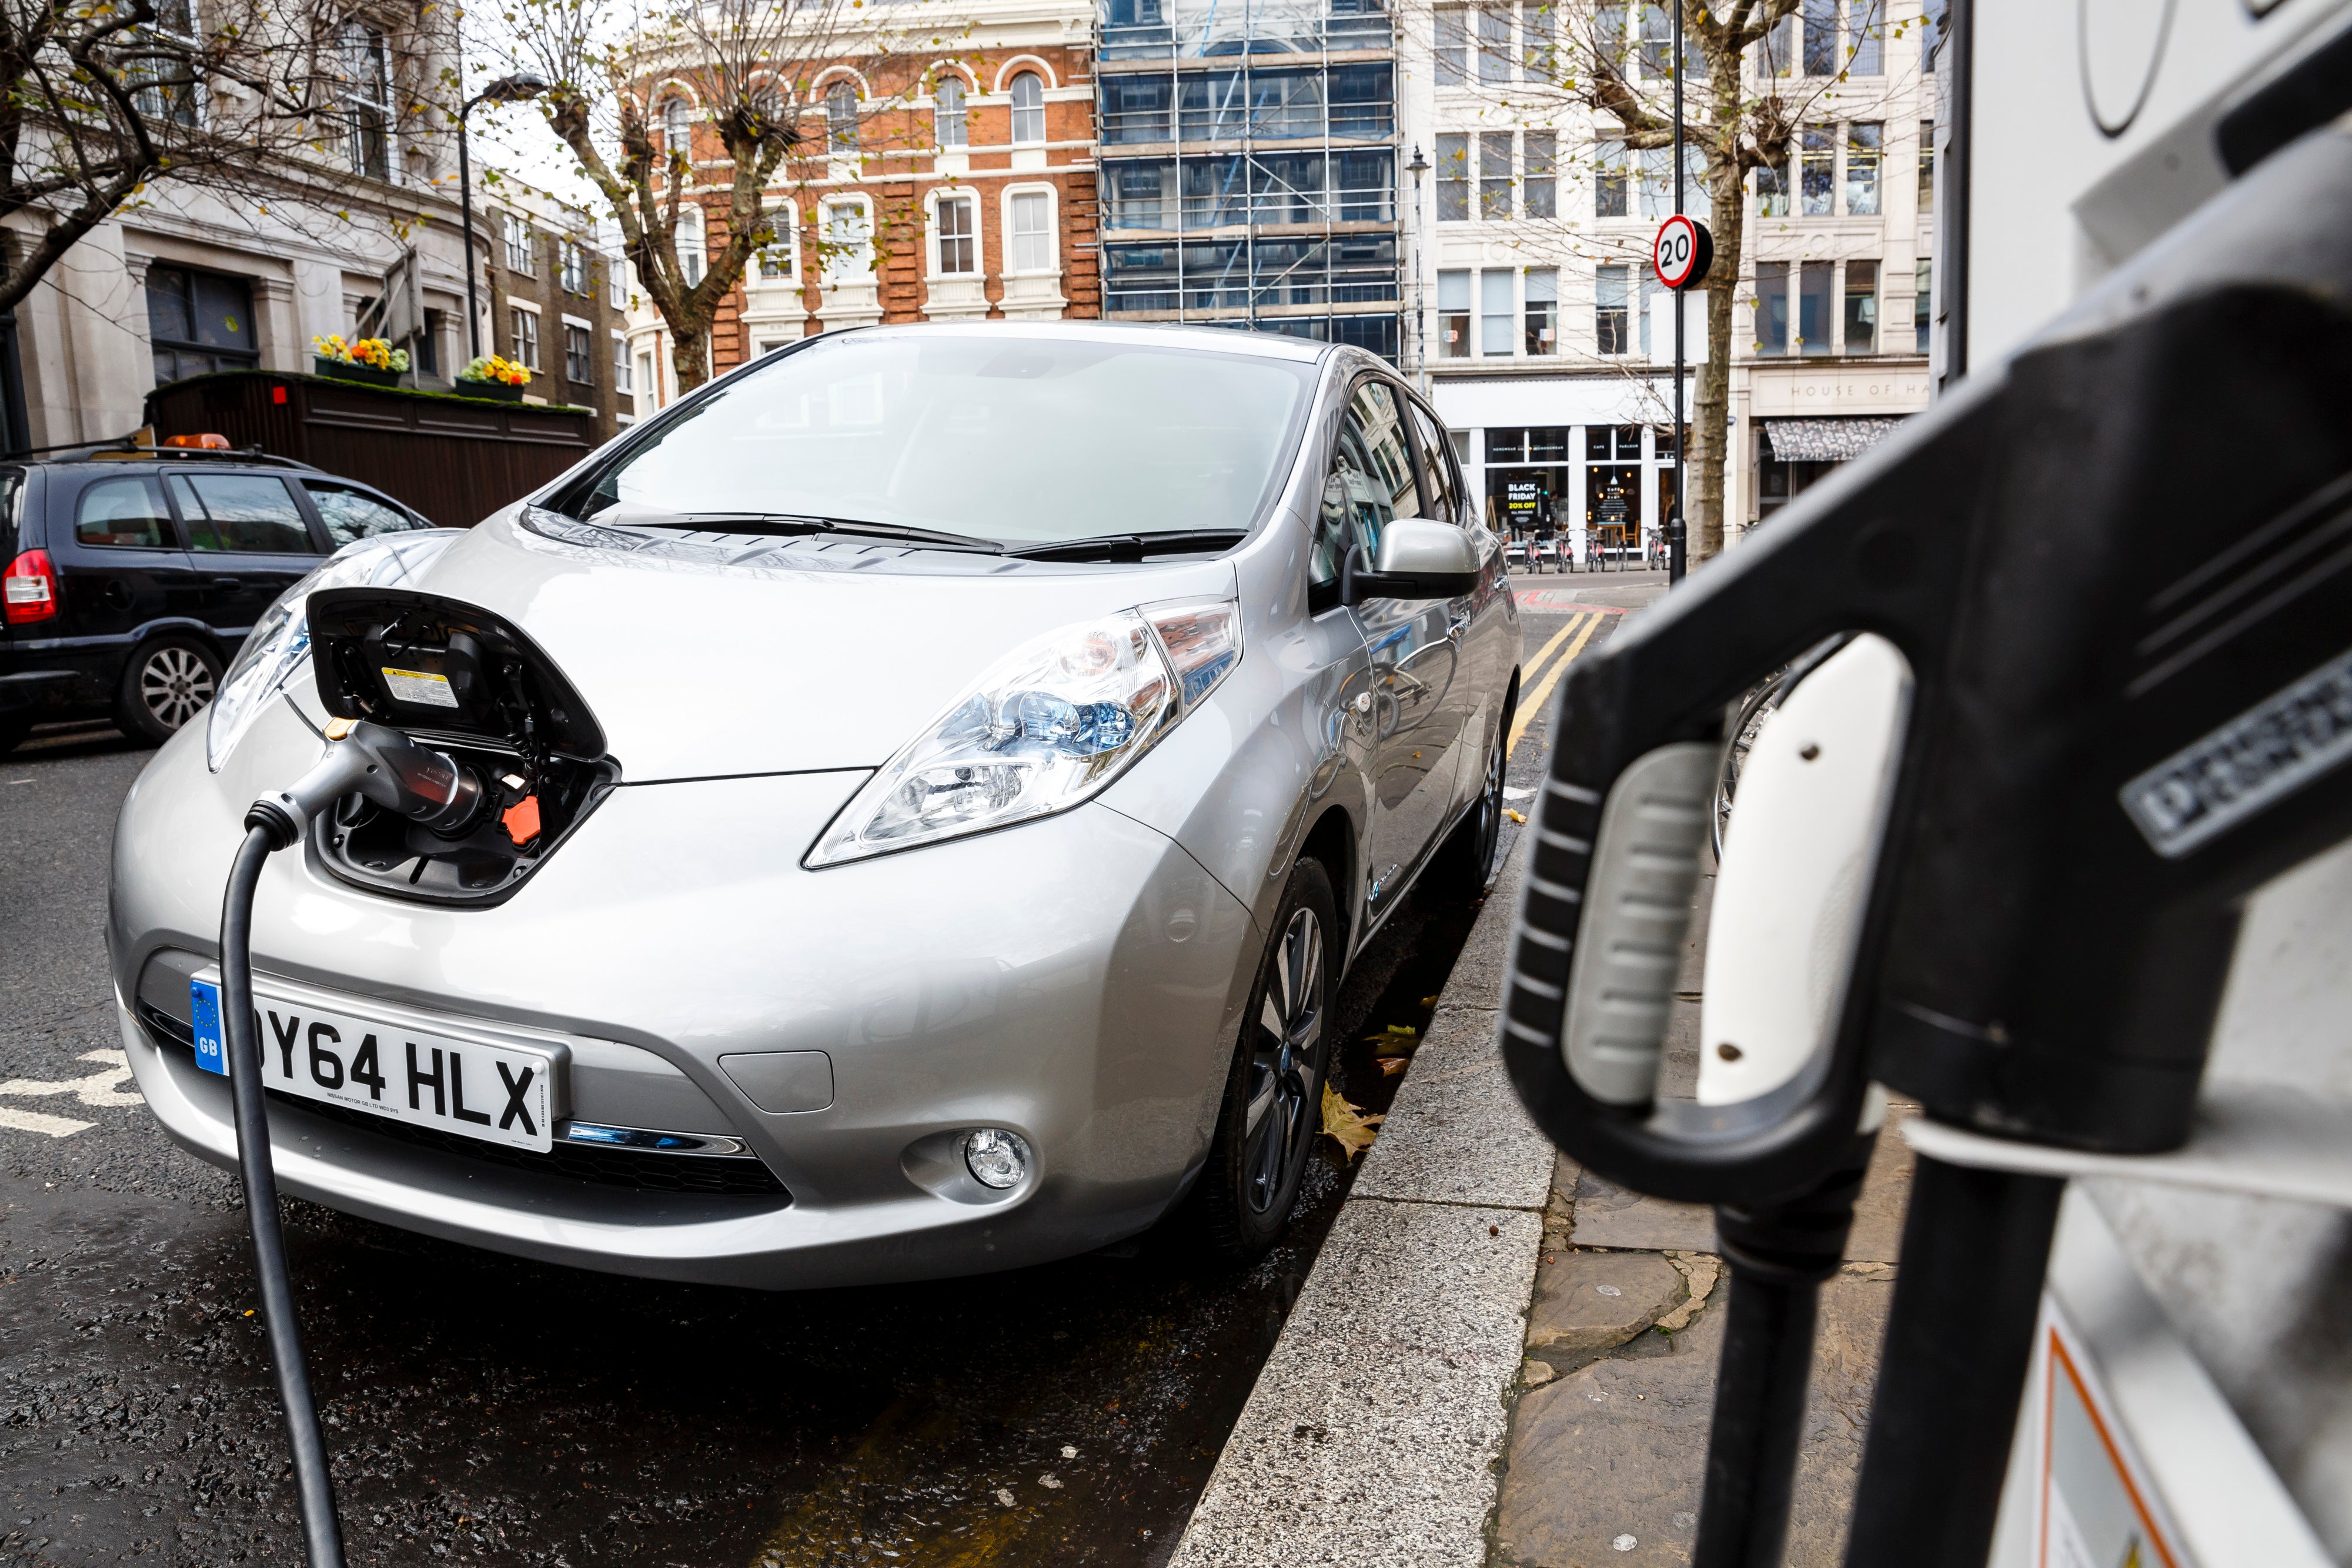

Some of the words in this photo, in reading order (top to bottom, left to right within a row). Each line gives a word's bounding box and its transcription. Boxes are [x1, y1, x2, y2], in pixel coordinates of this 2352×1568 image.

[1661, 234, 1689, 268] 20
[1791, 385, 1853, 396] HOUSE
[1869, 385, 1891, 395] OF
[199, 1037, 218, 1057] GB
[405, 1042, 537, 1136] HLX
[344, 1096, 361, 1105] MOTOR
